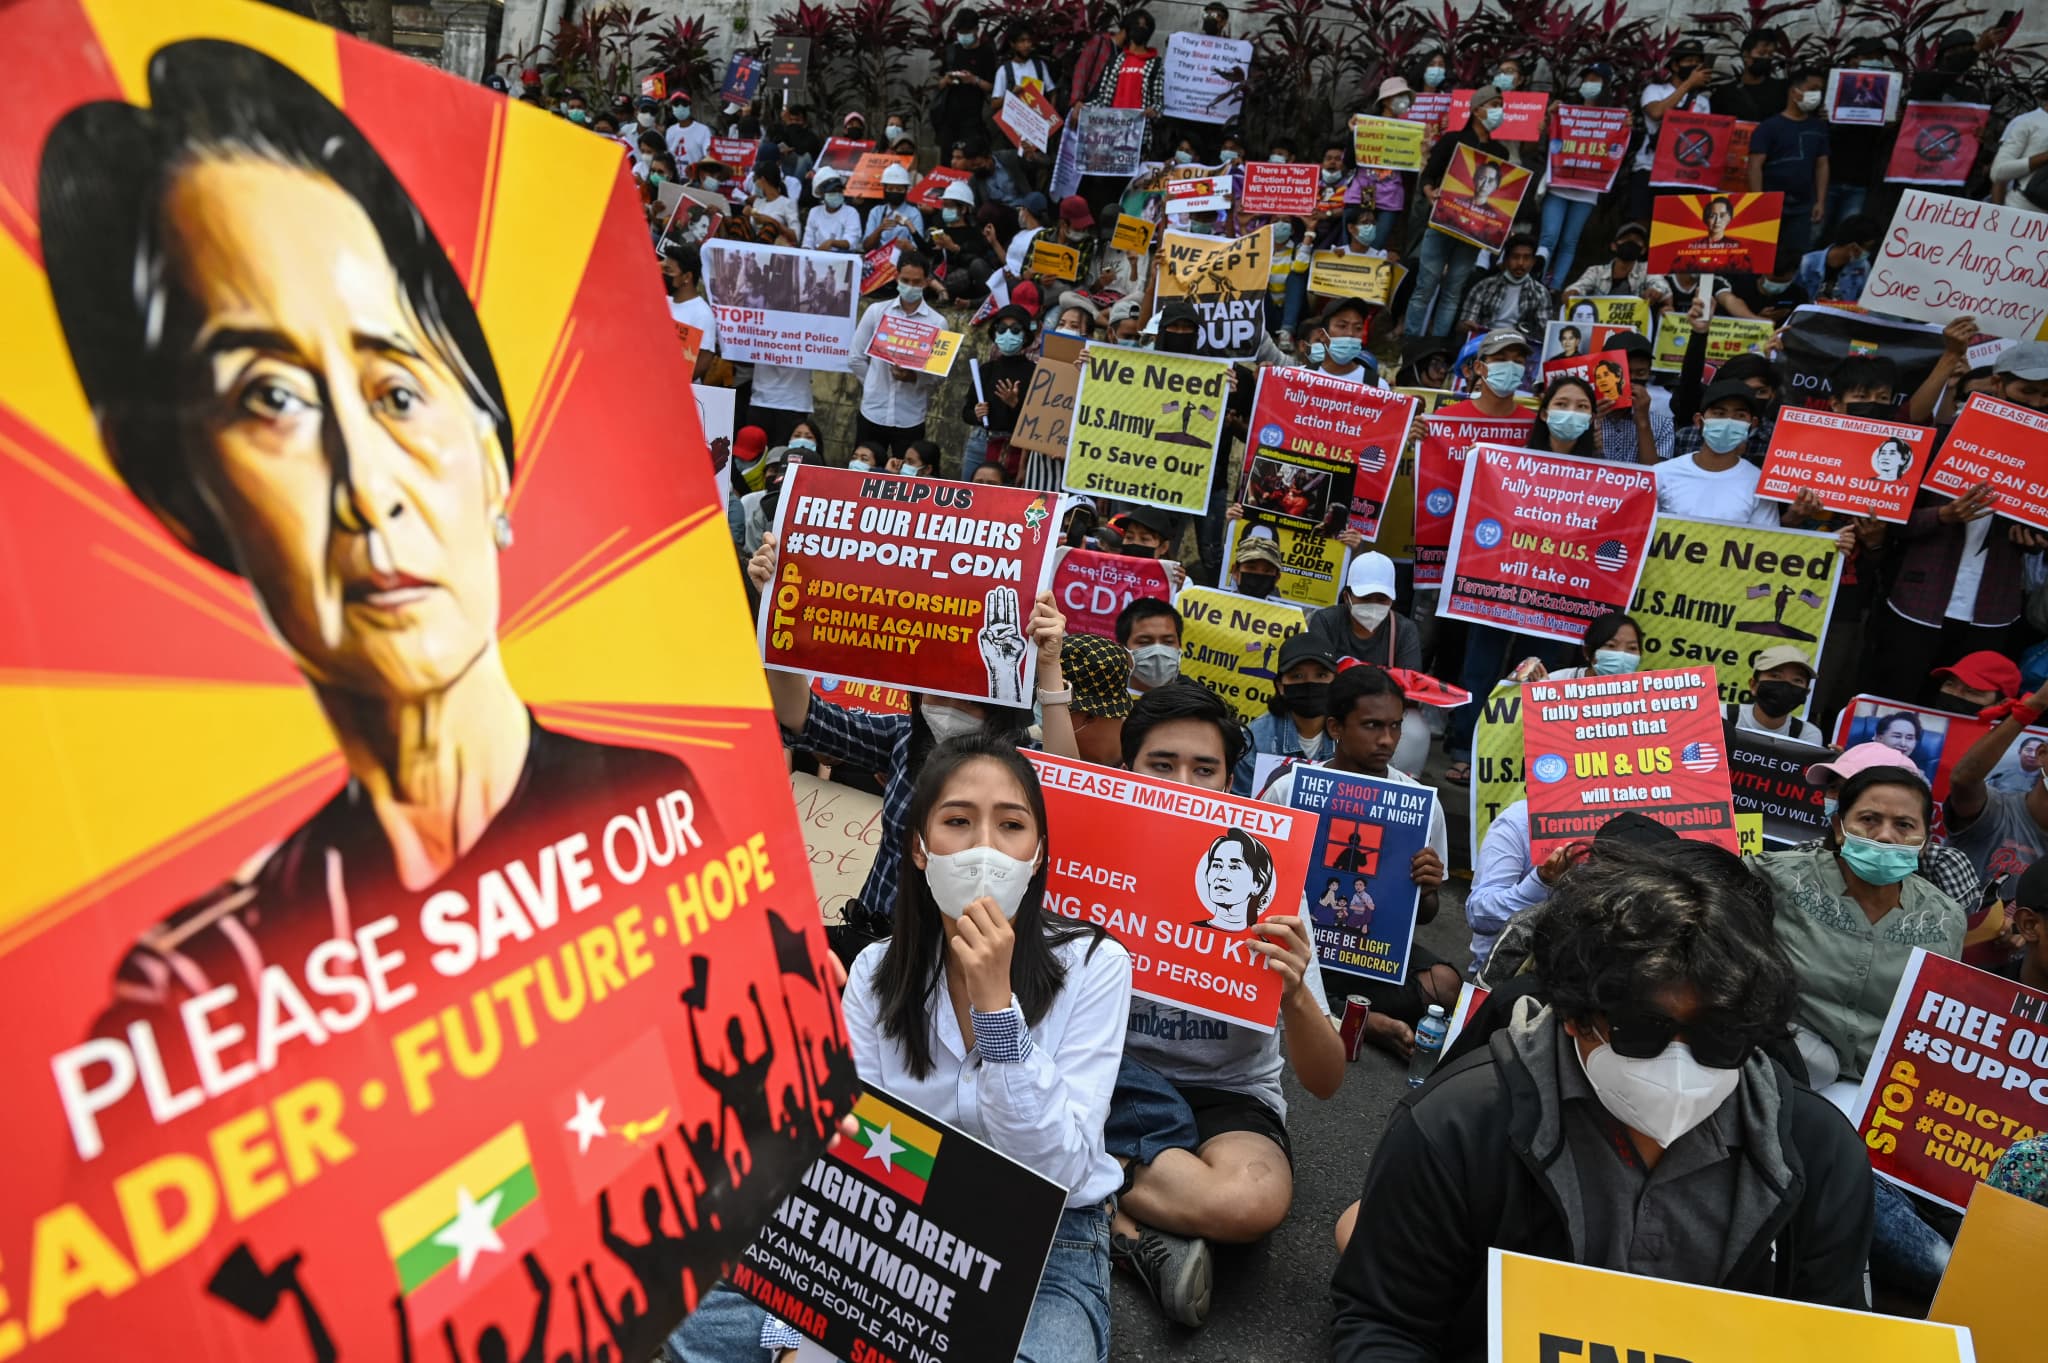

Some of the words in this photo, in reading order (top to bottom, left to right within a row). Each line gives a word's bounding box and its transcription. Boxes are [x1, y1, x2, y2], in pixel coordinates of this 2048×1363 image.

[1562, 139, 1577, 153] UN
[1253, 176, 1285, 184] Election
[1287, 177, 1311, 185] Fraud
[1256, 165, 1279, 174] There
[1265, 185, 1292, 193] VOTED
[1905, 195, 1981, 229] United
[1983, 209, 2000, 232] &
[1170, 244, 1202, 262] WE
[1885, 227, 1944, 265] Save
[1608, 302, 1637, 313] FREE
[1608, 311, 1634, 320] OUR
[1871, 269, 1920, 300] Save
[1925, 280, 2043, 337] Democracy
[738, 325, 778, 339] Military
[781, 328, 801, 340] and
[805, 332, 839, 344] Police
[754, 338, 802, 351] Innocent
[750, 352, 760, 361] at
[764, 353, 792, 365] Night
[1090, 357, 1135, 385] We
[1144, 365, 1223, 398] Need
[1270, 365, 1296, 382] We,
[1296, 370, 1360, 394] Myanmar
[1361, 381, 1408, 406] People,
[1284, 388, 1308, 411] Fully
[1309, 393, 1351, 418] support
[1351, 403, 1383, 422] every
[1976, 399, 2033, 424] RELEASE
[1078, 404, 1155, 439] U.S.Army
[1294, 413, 1333, 431] action
[1334, 421, 1362, 438] that
[1428, 422, 1455, 440] We,
[1457, 423, 1530, 442] Myanmar
[1786, 411, 1840, 429] RELEASE
[1840, 419, 1919, 441] IMMEDIATELY
[1078, 440, 1103, 460] To
[1108, 448, 1164, 474] Save
[1169, 458, 1205, 478] Our
[1291, 438, 1312, 456] UN
[1315, 443, 1326, 458] &
[1330, 445, 1354, 463] U.S.
[1774, 448, 1798, 460] OUR
[1799, 452, 1843, 468] LEADER
[1953, 439, 1978, 454] OUR
[1979, 448, 2026, 469] LEADER
[1485, 450, 1513, 470] We,
[1516, 459, 1594, 481] Myanmar
[1596, 468, 1654, 494] People,
[1770, 464, 1813, 482] AUNG
[1815, 471, 1847, 487] SAN
[1848, 477, 1881, 493] SUU
[1882, 483, 1910, 499] KYI
[1935, 472, 1961, 487] AND
[1944, 456, 1990, 479] AUNG
[1992, 471, 2026, 491] SAN
[860, 478, 931, 504] HELP
[932, 486, 974, 509] US
[1086, 473, 1184, 505] Situation
[1501, 476, 1532, 497] Fully
[1534, 483, 1586, 504] support
[1588, 492, 1623, 513] every
[1767, 480, 1789, 492] AND
[1848, 493, 1901, 512] PERSONS
[794, 496, 859, 531] FREE
[859, 505, 912, 537] OUR
[914, 516, 1023, 551] LEADERS
[1514, 504, 1564, 524] action
[1565, 511, 1598, 530] that
[1293, 531, 1326, 547] FREE
[1293, 543, 1325, 559] OUR
[1511, 534, 1538, 551] UN
[1540, 539, 1555, 555] &
[1559, 542, 1590, 562] U.S.
[786, 532, 1023, 582] #SUPPORT_CDM
[1281, 552, 1334, 573] LEADER
[1649, 532, 1709, 565] We
[1720, 539, 1835, 582] Need
[1456, 577, 1516, 601] Terrorist
[1500, 561, 1528, 577] will
[1532, 568, 1566, 585] take
[1570, 576, 1590, 589] on
[771, 562, 803, 651] STOP
[807, 578, 983, 616] #DICTATORSHIP
[802, 605, 878, 632] #CRIME
[880, 616, 974, 644] AGAINST
[1182, 598, 1223, 623] We
[1229, 609, 1302, 639] Need
[812, 626, 922, 656] HUMANITY
[1670, 638, 1740, 668] Save
[1531, 685, 1562, 702] We,
[1564, 678, 1640, 700] Myanmar
[1642, 672, 1706, 694] People,
[1541, 703, 1579, 722] fully
[1582, 699, 1648, 719] support
[1650, 695, 1698, 713] every
[1575, 722, 1629, 741] action
[1631, 718, 1667, 736] that
[1574, 752, 1610, 779] UN
[1613, 751, 1633, 776] &
[1637, 746, 1673, 774] US
[1780, 758, 1800, 773] OF
[1032, 763, 1128, 800] RELEASE
[1131, 786, 1286, 836] IMMEDIATELY
[1301, 775, 1335, 796] THEY
[1336, 781, 1381, 801] SHOOT
[1383, 790, 1399, 805] IN
[1401, 793, 1427, 812] DAY
[1581, 788, 1611, 805] will
[1613, 785, 1648, 802] take
[1650, 784, 1672, 799] on
[1775, 781, 1806, 801] UN
[1298, 791, 1329, 810] THEY
[1331, 798, 1366, 817] STEAL
[1370, 806, 1385, 820] AT
[1387, 808, 1424, 827] NIGHT
[1761, 799, 1787, 818] YOU
[1789, 808, 1817, 826] WILL
[1056, 860, 1138, 894] LEADER
[1088, 904, 1148, 938] SAN
[1154, 919, 1215, 957] SUU
[1343, 935, 1357, 949] BE
[1359, 937, 1391, 956] LIGHT
[51, 915, 418, 1162] PLEASE
[418, 830, 602, 978] SAVE
[601, 787, 704, 888] OUR
[390, 907, 659, 1118] FUTURE
[663, 831, 778, 948] HOPE
[1323, 947, 1336, 960] BE
[1339, 950, 1399, 974] DEMOCRACY
[1156, 959, 1259, 1003] PERSONS
[1916, 990, 2007, 1050] FREE
[1865, 1060, 1921, 1154] STOP
[896, 1208, 1002, 1295] AREN'T
[817, 1217, 958, 1324] ANYMORE
[732, 1260, 829, 1342] MYANMAR
[841, 1275, 930, 1340] MILITARY
[930, 1328, 949, 1353] IS
[810, 1280, 883, 1340] PEOPLE
[884, 1333, 908, 1355] AT
